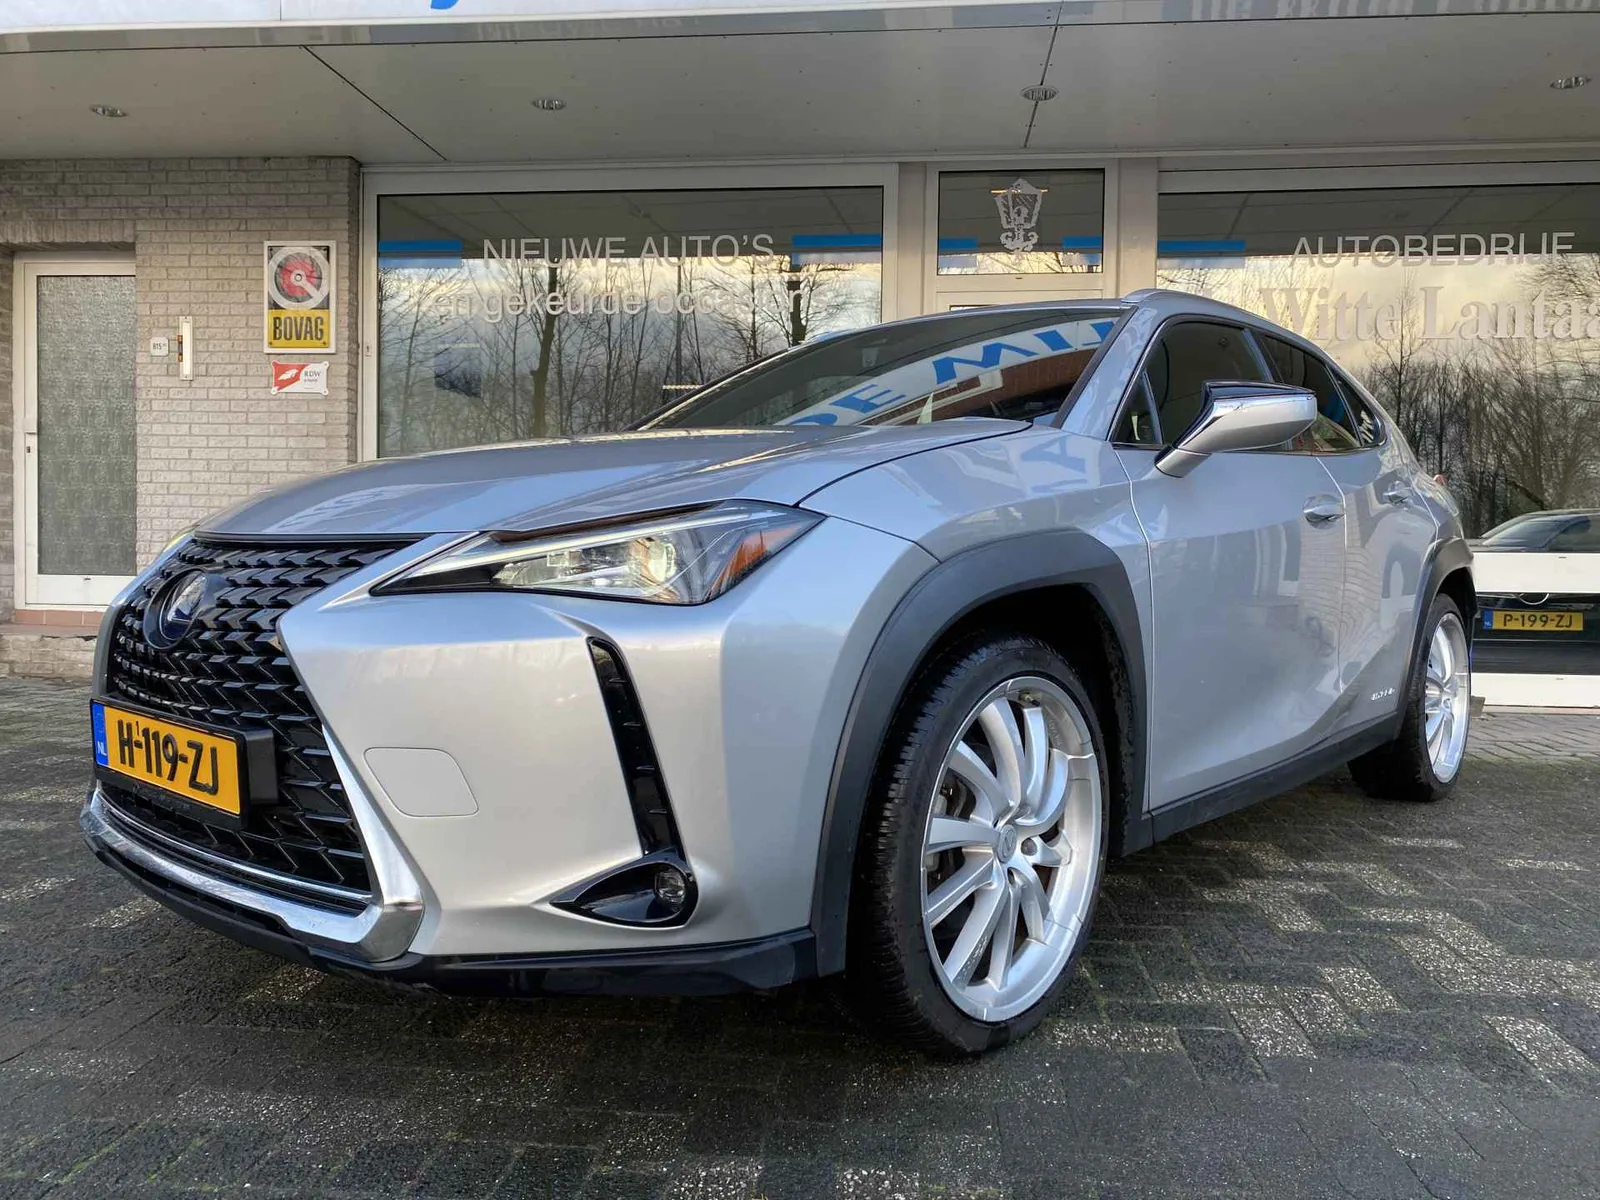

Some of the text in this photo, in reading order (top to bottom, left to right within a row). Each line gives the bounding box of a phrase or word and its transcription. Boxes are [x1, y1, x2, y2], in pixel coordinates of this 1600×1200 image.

[483, 234, 775, 270] NIEUWE AUTO'S
[1289, 231, 1576, 268] AUTOBEDRIJF
[483, 288, 642, 324] gekeurde
[272, 316, 325, 341] BOVAG
[1503, 613, 1573, 628] P-199-ZJ
[117, 718, 220, 796] H-119-ZJ
